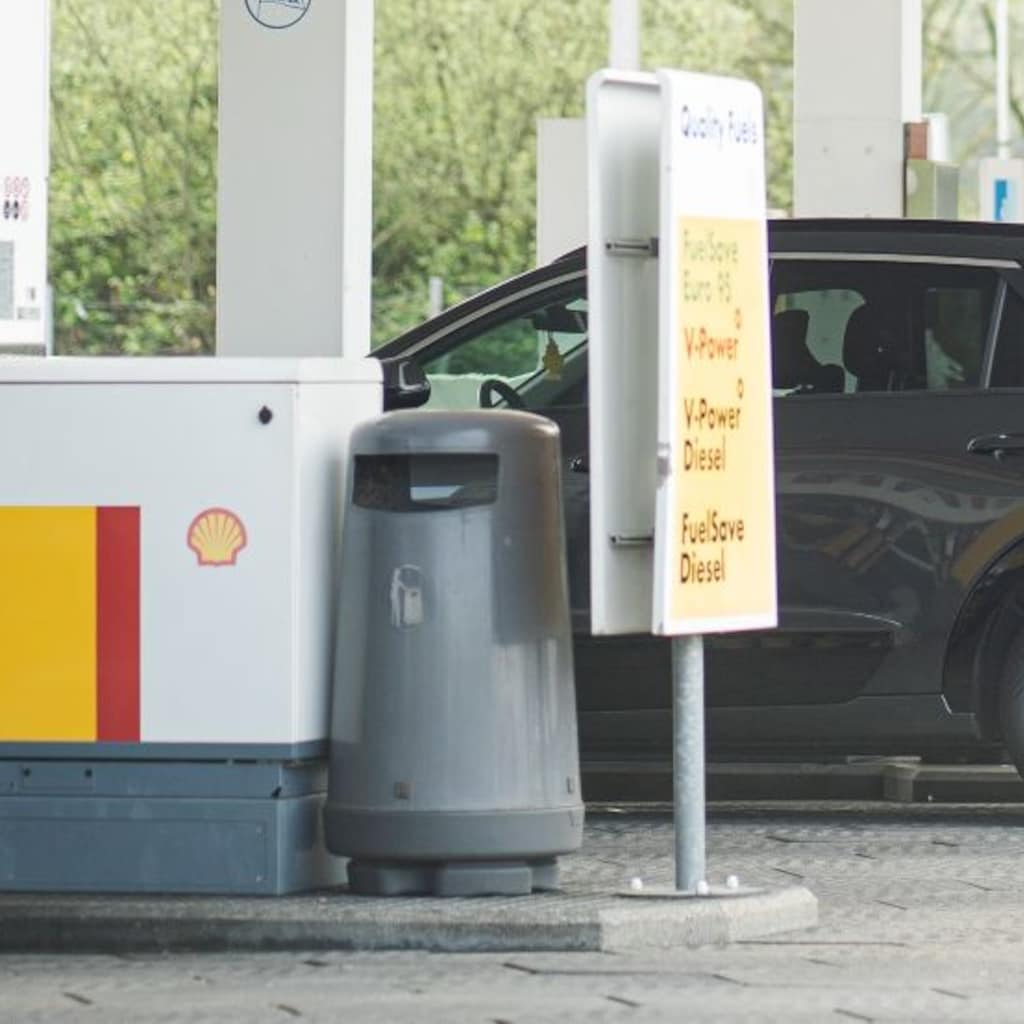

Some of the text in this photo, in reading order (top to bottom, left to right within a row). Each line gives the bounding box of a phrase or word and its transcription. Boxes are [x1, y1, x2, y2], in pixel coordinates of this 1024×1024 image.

[682, 104, 758, 151] Quality Fuels
[684, 228, 739, 264] FuelSave
[684, 268, 711, 303] Euro
[684, 326, 739, 361] V-Power
[684, 397, 742, 429] V-Power
[683, 433, 727, 472] Diesel
[681, 508, 745, 544] FuelSave
[680, 549, 726, 584] Diesel
